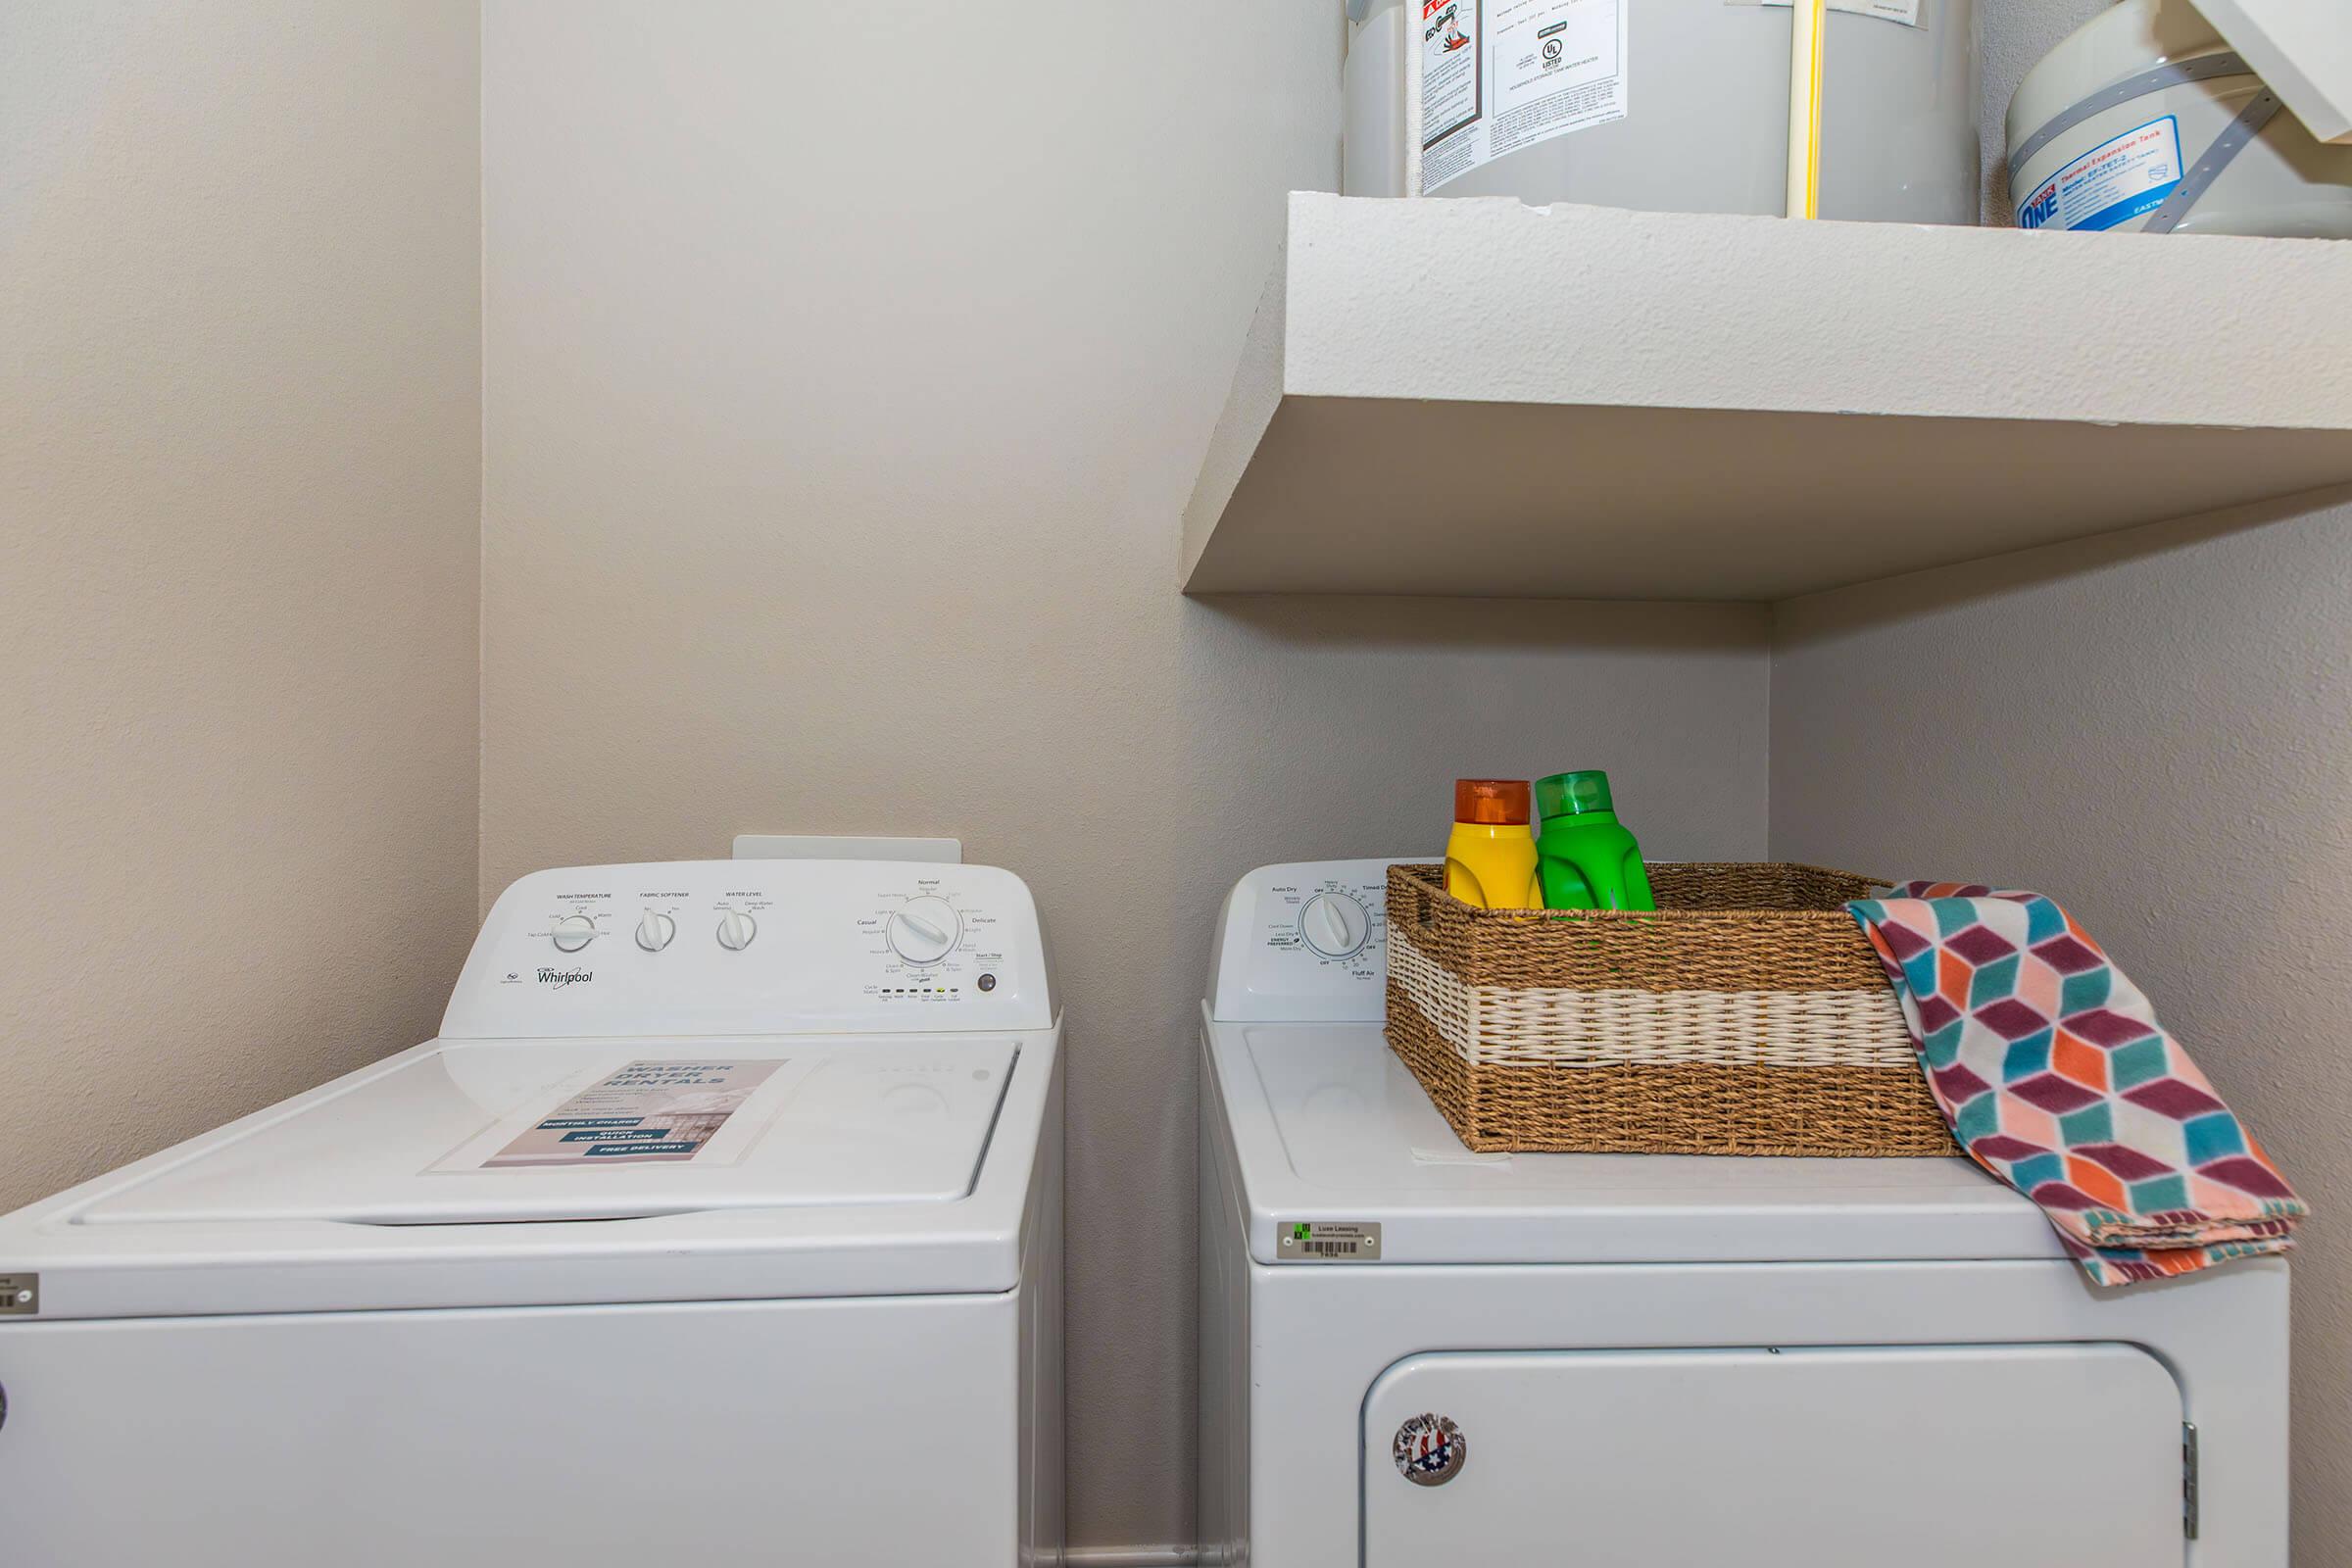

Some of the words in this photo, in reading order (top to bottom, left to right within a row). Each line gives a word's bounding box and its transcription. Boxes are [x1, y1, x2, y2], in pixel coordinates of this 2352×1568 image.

[1547, 42, 1557, 55] UL
[1543, 57, 1562, 69] LISTED
[1582, 56, 1599, 67] HEATER
[2061, 162, 2090, 183] Thermal
[2091, 140, 2136, 166] Expansion
[2139, 129, 2161, 143] Tank
[2062, 176, 2086, 192] Model:
[2022, 193, 2059, 229] ONE
[538, 971, 593, 986] Whirlpool
